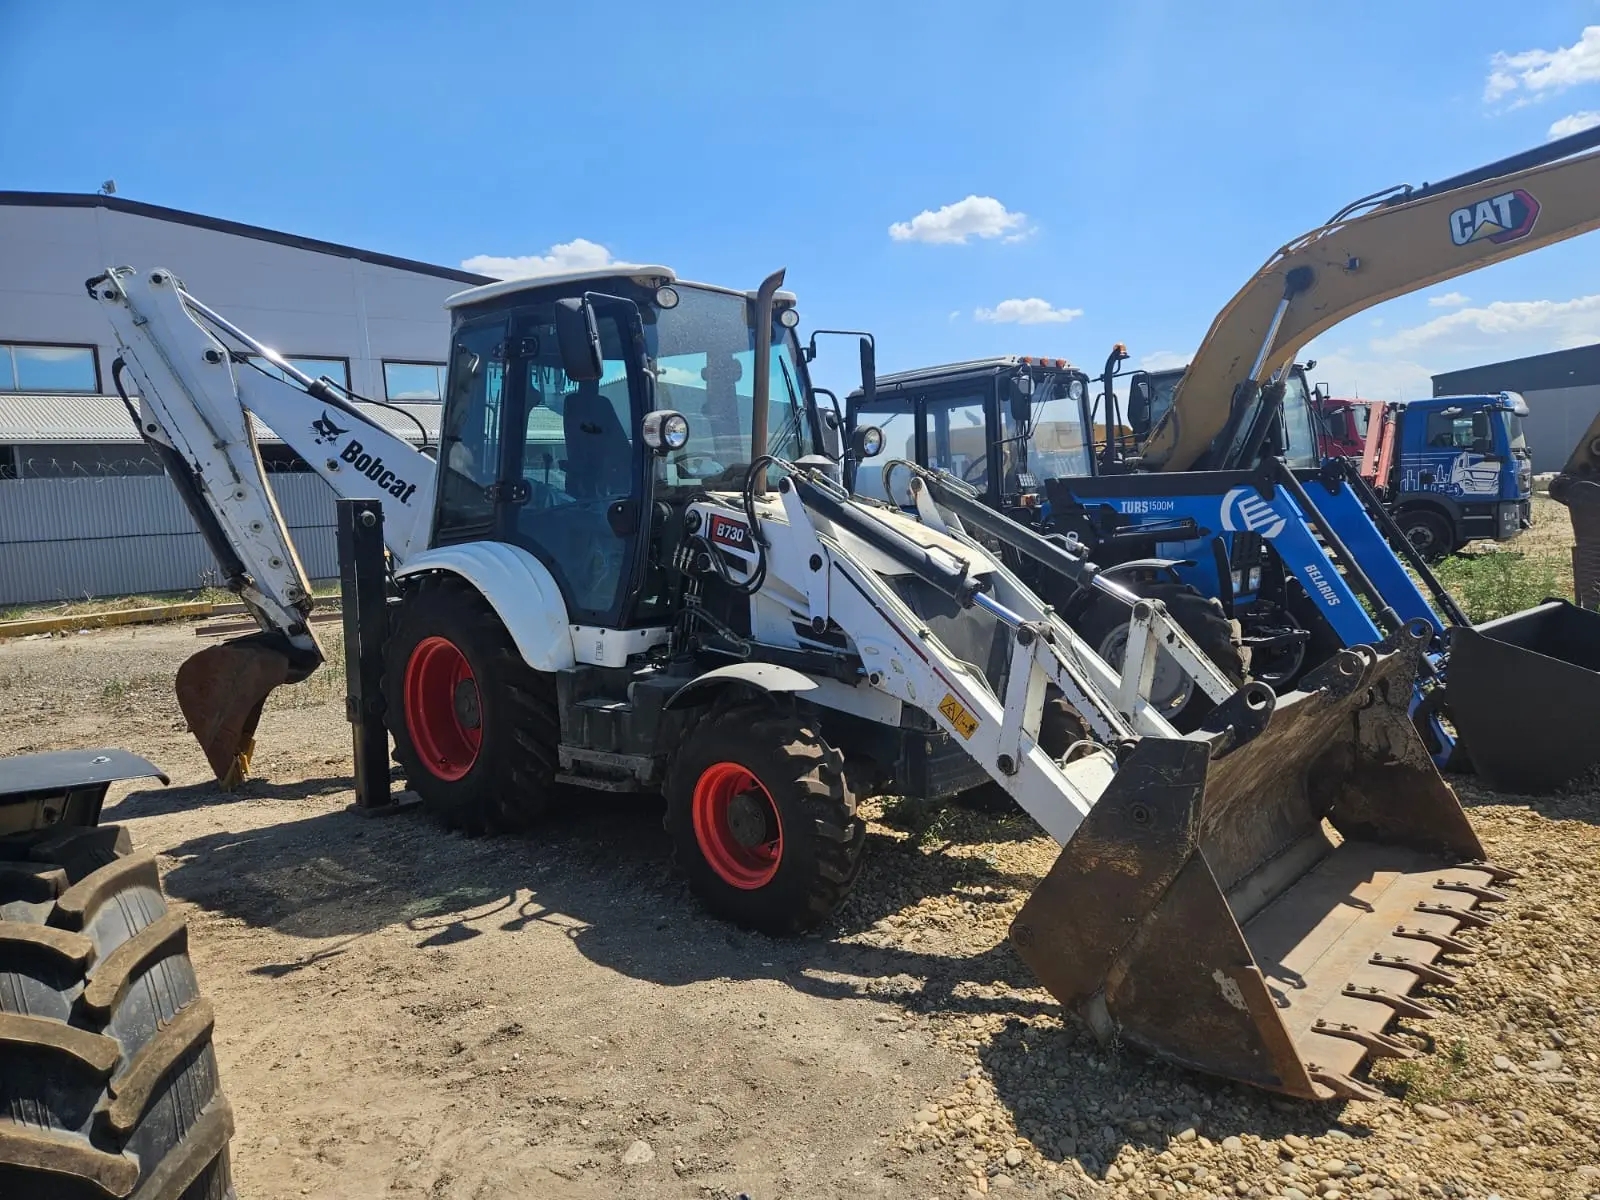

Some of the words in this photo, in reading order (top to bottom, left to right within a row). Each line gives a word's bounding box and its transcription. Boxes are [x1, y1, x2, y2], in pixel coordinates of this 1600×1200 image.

[1450, 192, 1515, 245] CAT
[340, 439, 417, 504] Bobcat
[716, 523, 744, 542] B730
[1304, 564, 1341, 606] BELARUS
